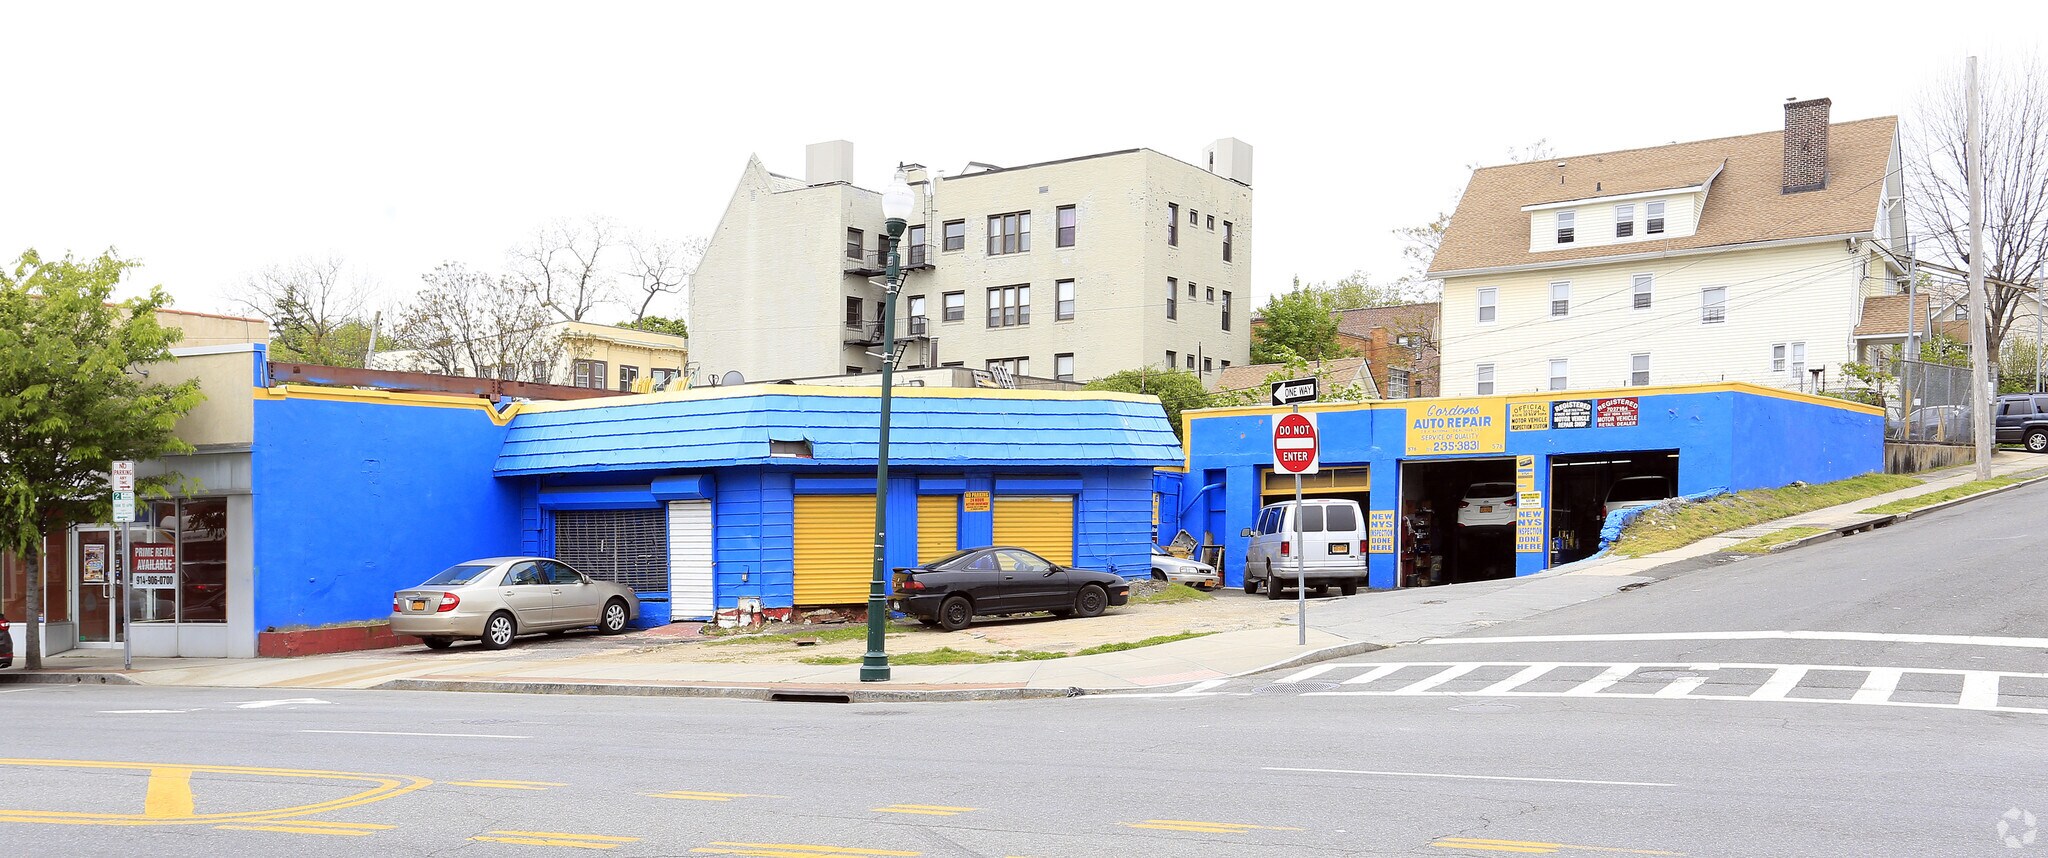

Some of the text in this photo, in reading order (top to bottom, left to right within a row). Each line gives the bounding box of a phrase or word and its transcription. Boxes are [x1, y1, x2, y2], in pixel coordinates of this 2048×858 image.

[1285, 386, 1312, 397] ONE WAY
[1514, 404, 1545, 413] OFFICIAL
[1554, 402, 1591, 412] REGISTERED
[1598, 399, 1638, 411] REGISTERED
[1414, 416, 1492, 429] AUTO REPAIR
[1280, 425, 1310, 435] DO NOT
[1284, 452, 1308, 462] ENTER
[135, 548, 174, 556] PRIME RETAIL
[137, 560, 172, 570] AVAILABLE
[136, 576, 173, 584] 914-906-0700
